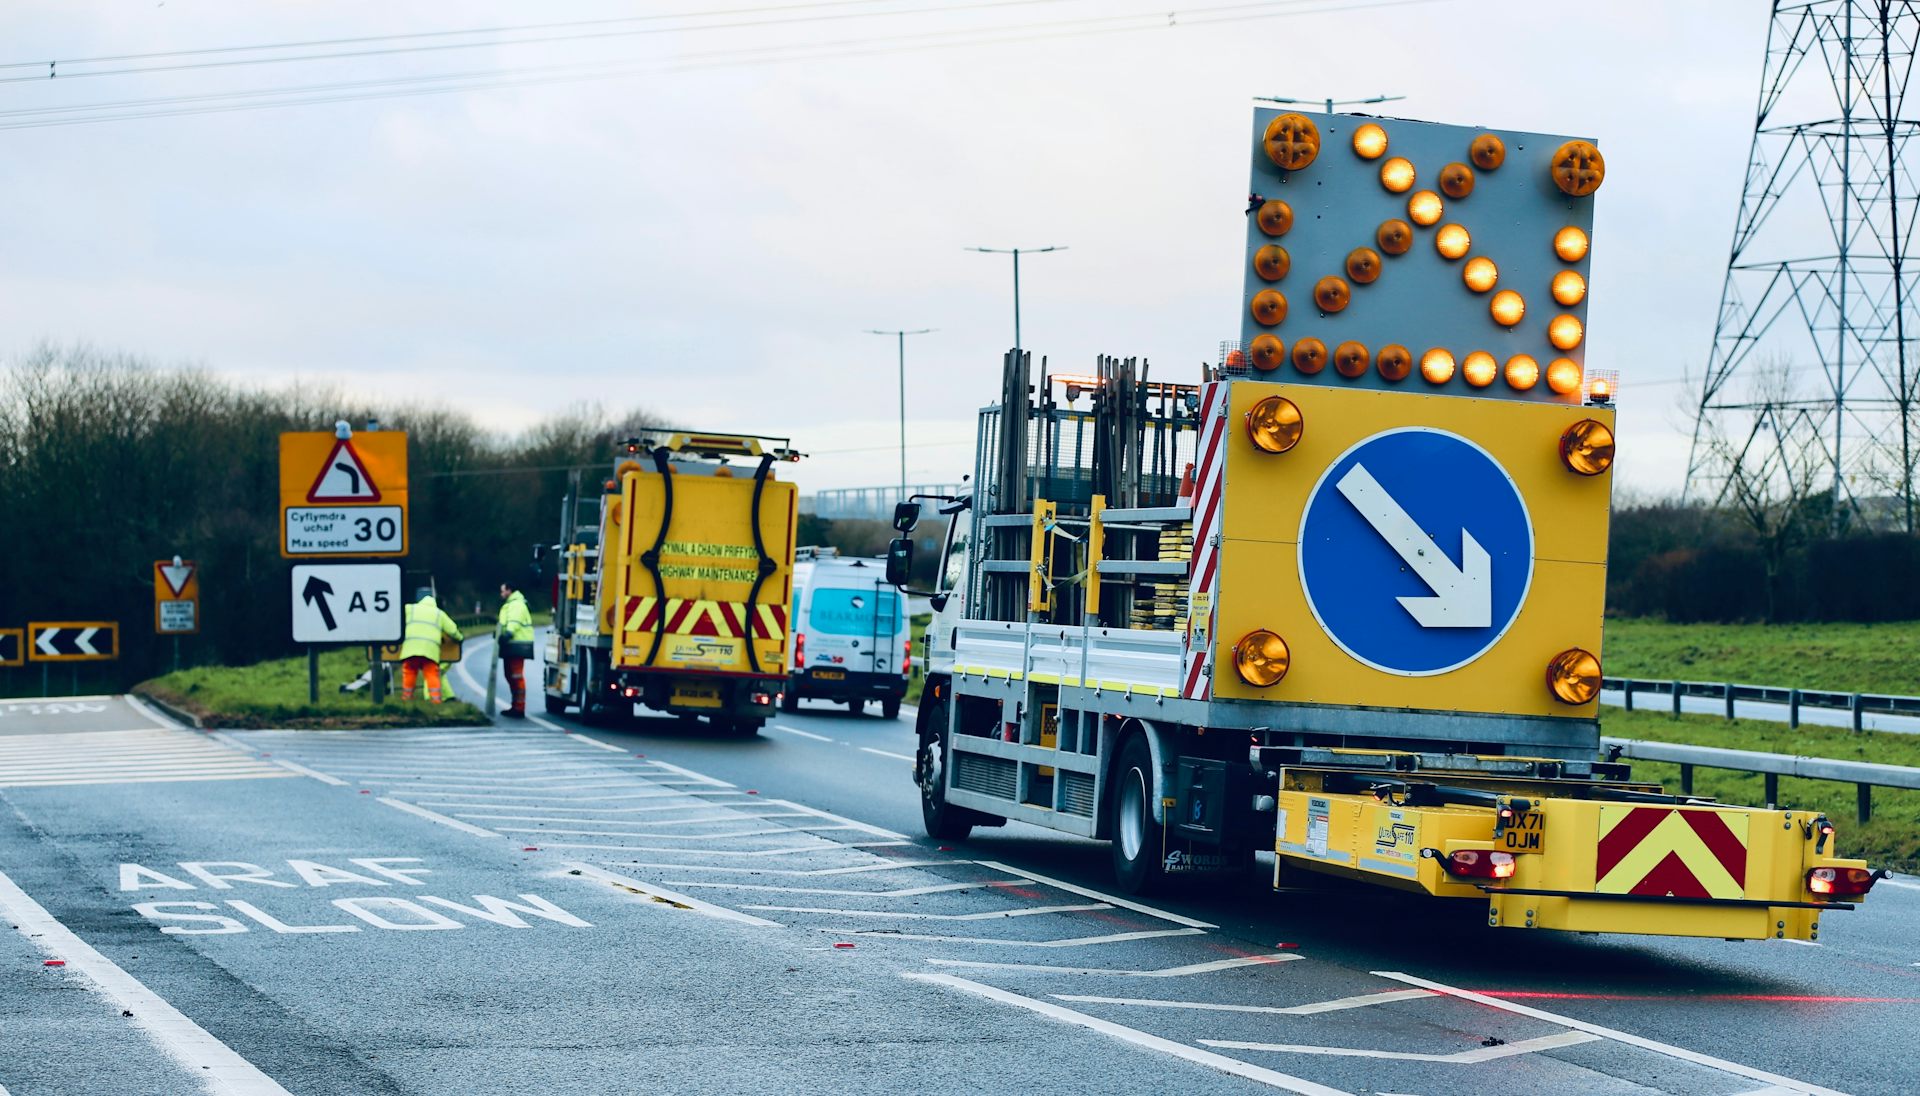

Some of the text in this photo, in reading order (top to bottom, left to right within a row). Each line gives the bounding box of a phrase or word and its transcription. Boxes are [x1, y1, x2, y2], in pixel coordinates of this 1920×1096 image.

[291, 512, 346, 523] Cyflymdra
[303, 523, 334, 533] uchaf
[354, 517, 396, 542] 30
[291, 539, 349, 550] Max speed
[690, 544, 696, 554] A
[660, 565, 755, 582] HIGHWAY MAINTENANCE
[348, 590, 390, 613] A5
[1506, 832, 1540, 849] OJM
[118, 857, 433, 891] ARAF
[132, 894, 594, 934] SLOW
